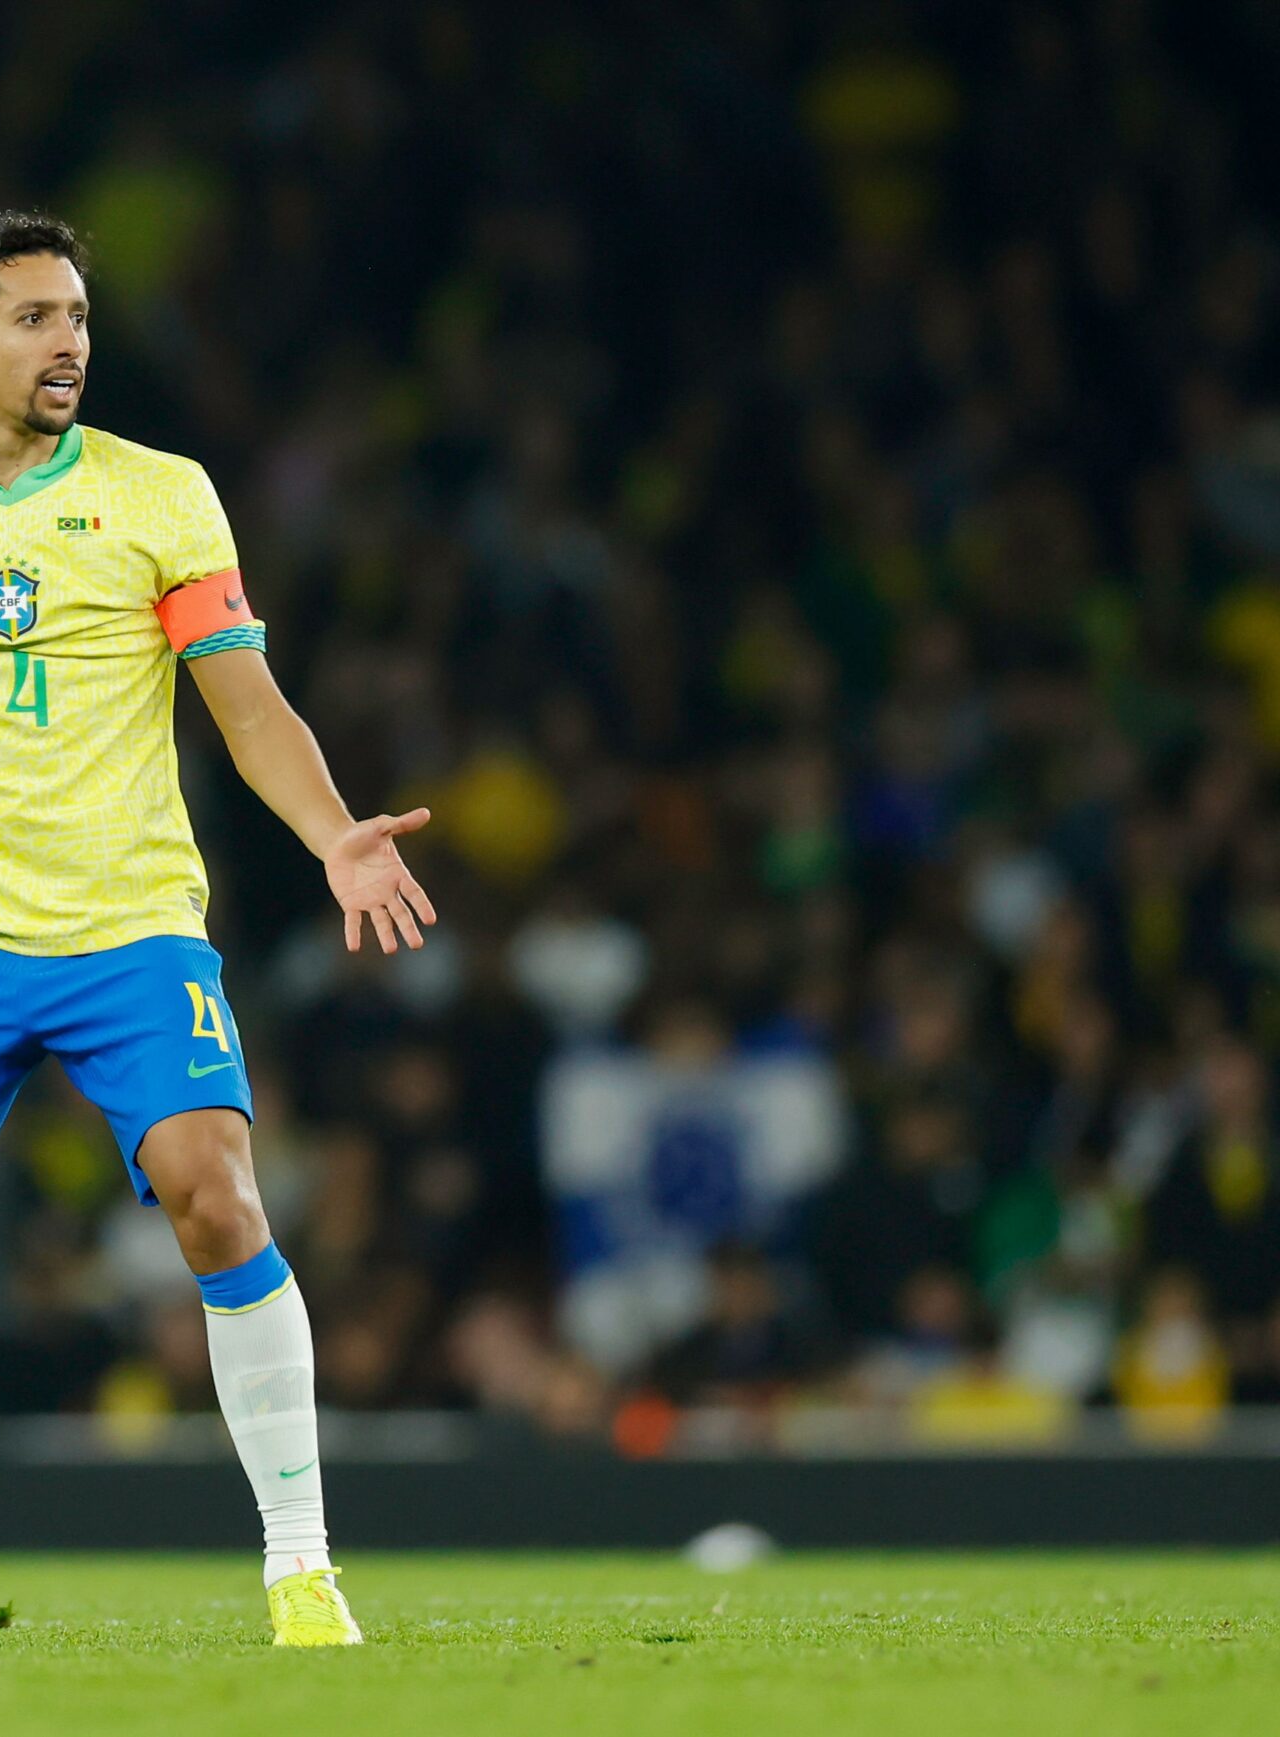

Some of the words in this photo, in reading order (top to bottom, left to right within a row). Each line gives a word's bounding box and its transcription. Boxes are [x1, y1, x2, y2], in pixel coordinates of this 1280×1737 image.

[0, 597, 21, 607] CBF
[5, 650, 49, 727] 4
[183, 982, 230, 1053] 4
